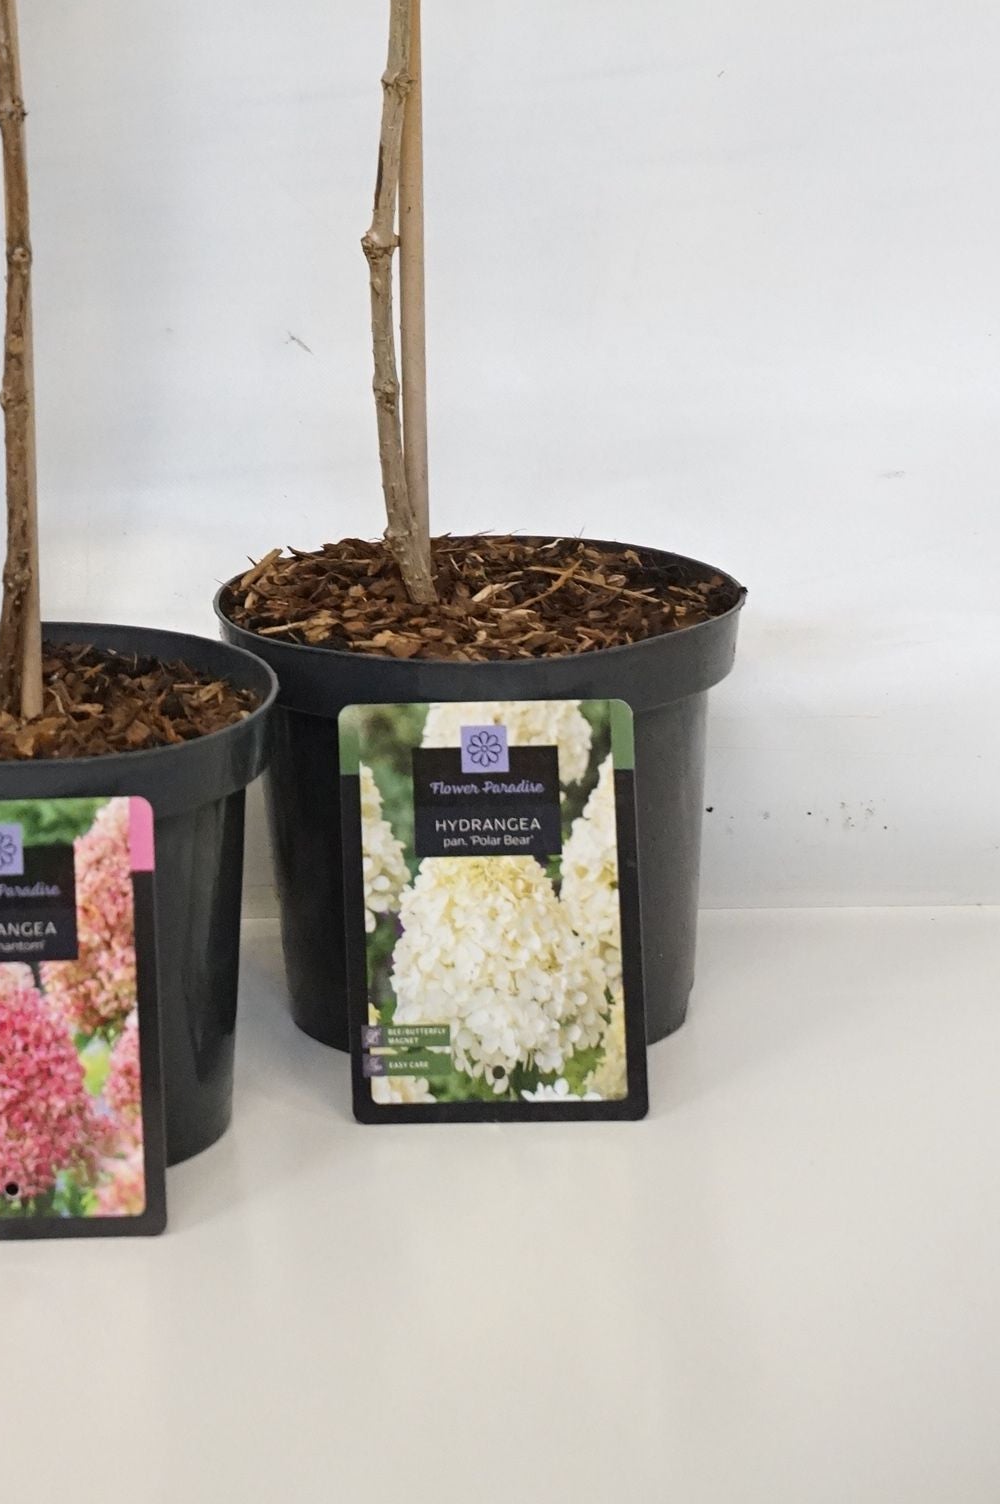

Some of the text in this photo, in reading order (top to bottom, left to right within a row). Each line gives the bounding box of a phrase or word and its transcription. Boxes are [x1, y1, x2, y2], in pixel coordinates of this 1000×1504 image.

[429, 779, 545, 795] Flower Paradise
[435, 817, 541, 832] HYDRANGEA
[443, 837, 468, 848] pan.
